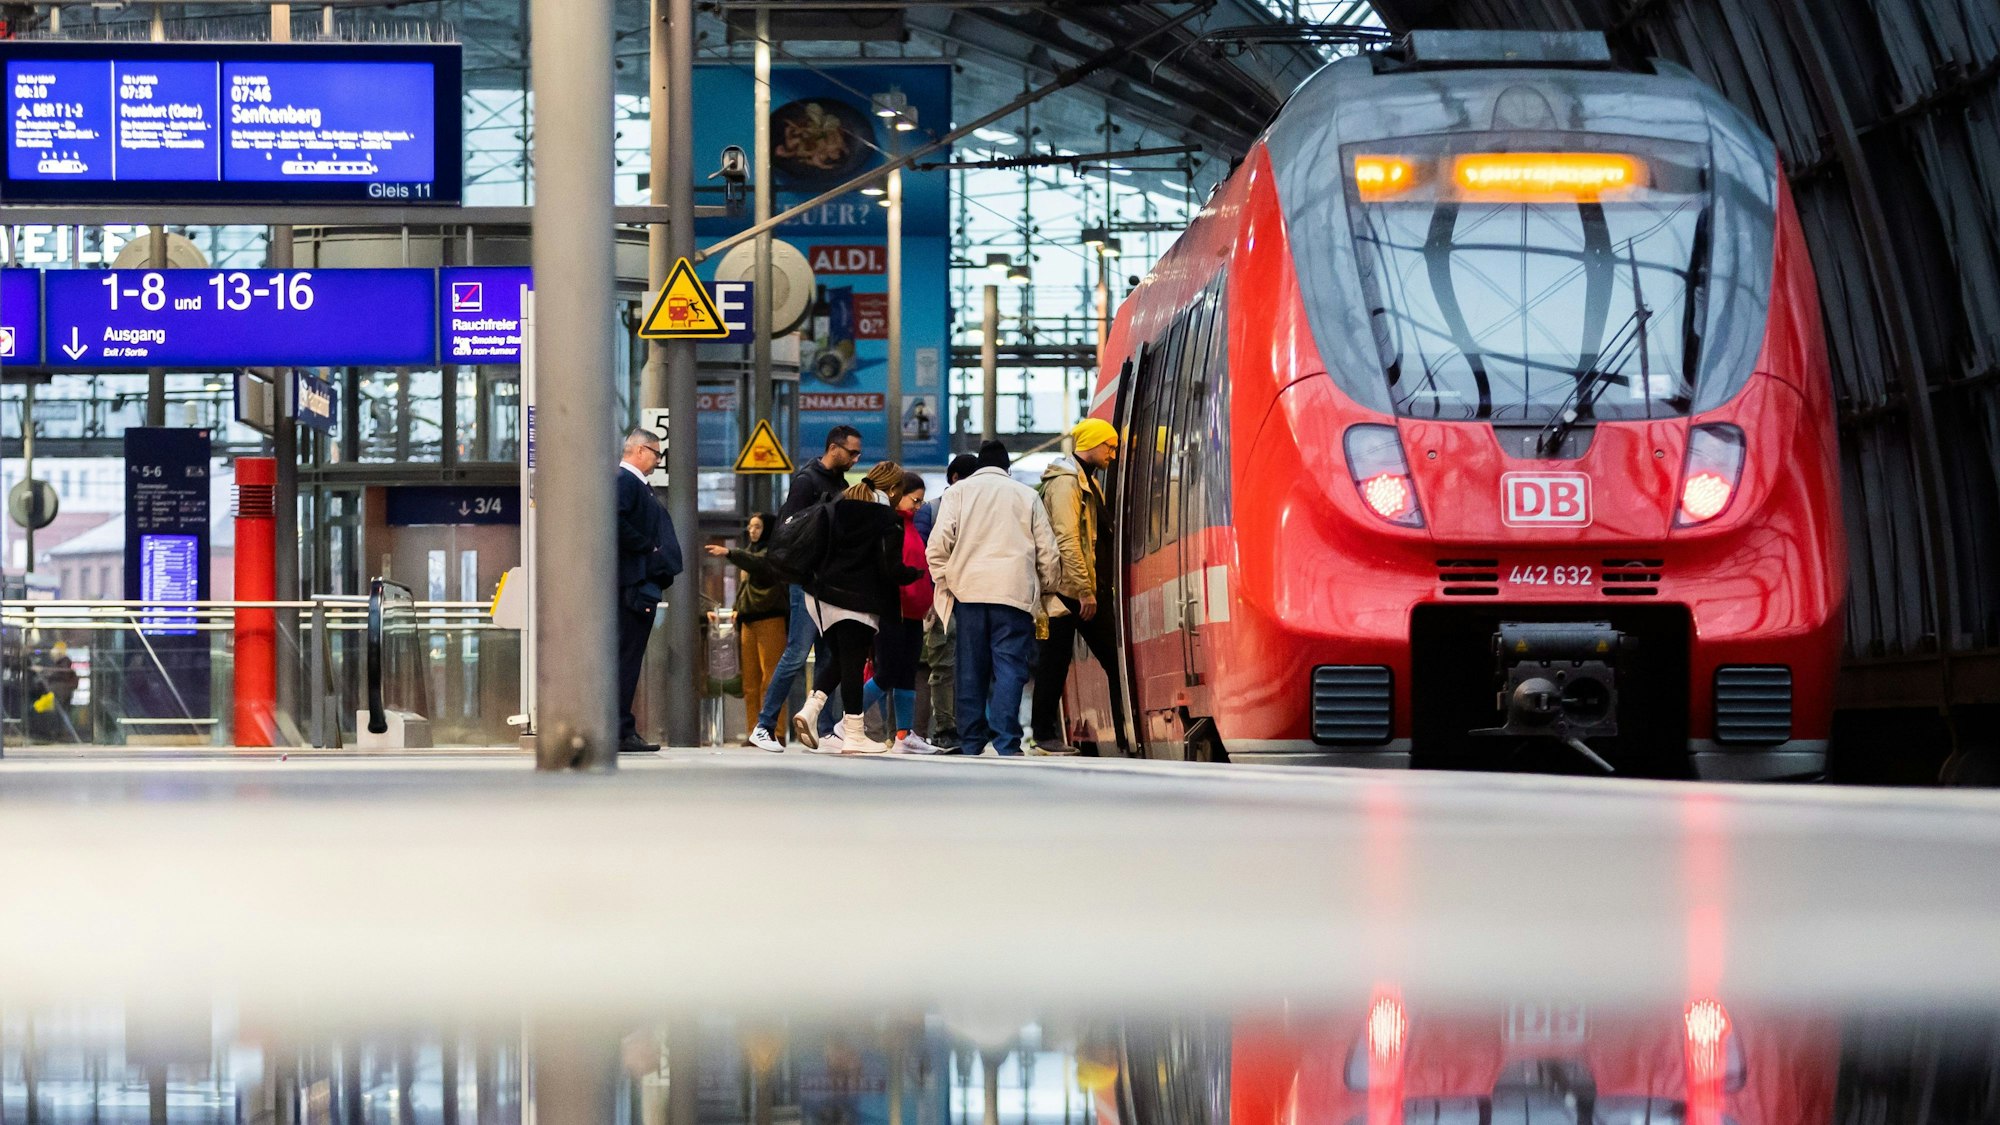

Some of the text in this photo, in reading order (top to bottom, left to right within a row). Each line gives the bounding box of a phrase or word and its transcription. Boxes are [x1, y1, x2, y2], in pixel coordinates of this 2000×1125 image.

[231, 86, 272, 102] 07:46
[121, 103, 203, 120] Frankfurt (Oder)
[231, 104, 321, 128] Senftenberg
[368, 183, 431, 198] Gleis 11
[102, 272, 315, 311] 1-8 und 13-16
[716, 283, 746, 331] E
[452, 319, 518, 331] Rauchfreier
[103, 326, 166, 344] Ausgang
[103, 347, 119, 357] Exit
[125, 347, 148, 357] Sortie
[472, 346, 518, 356] non-fumeur
[656, 415, 669, 441] 5
[142, 465, 162, 478] 5-6
[474, 497, 502, 515] 3/4
[1513, 481, 1580, 517] DB
[1508, 565, 1593, 586] 442 632
